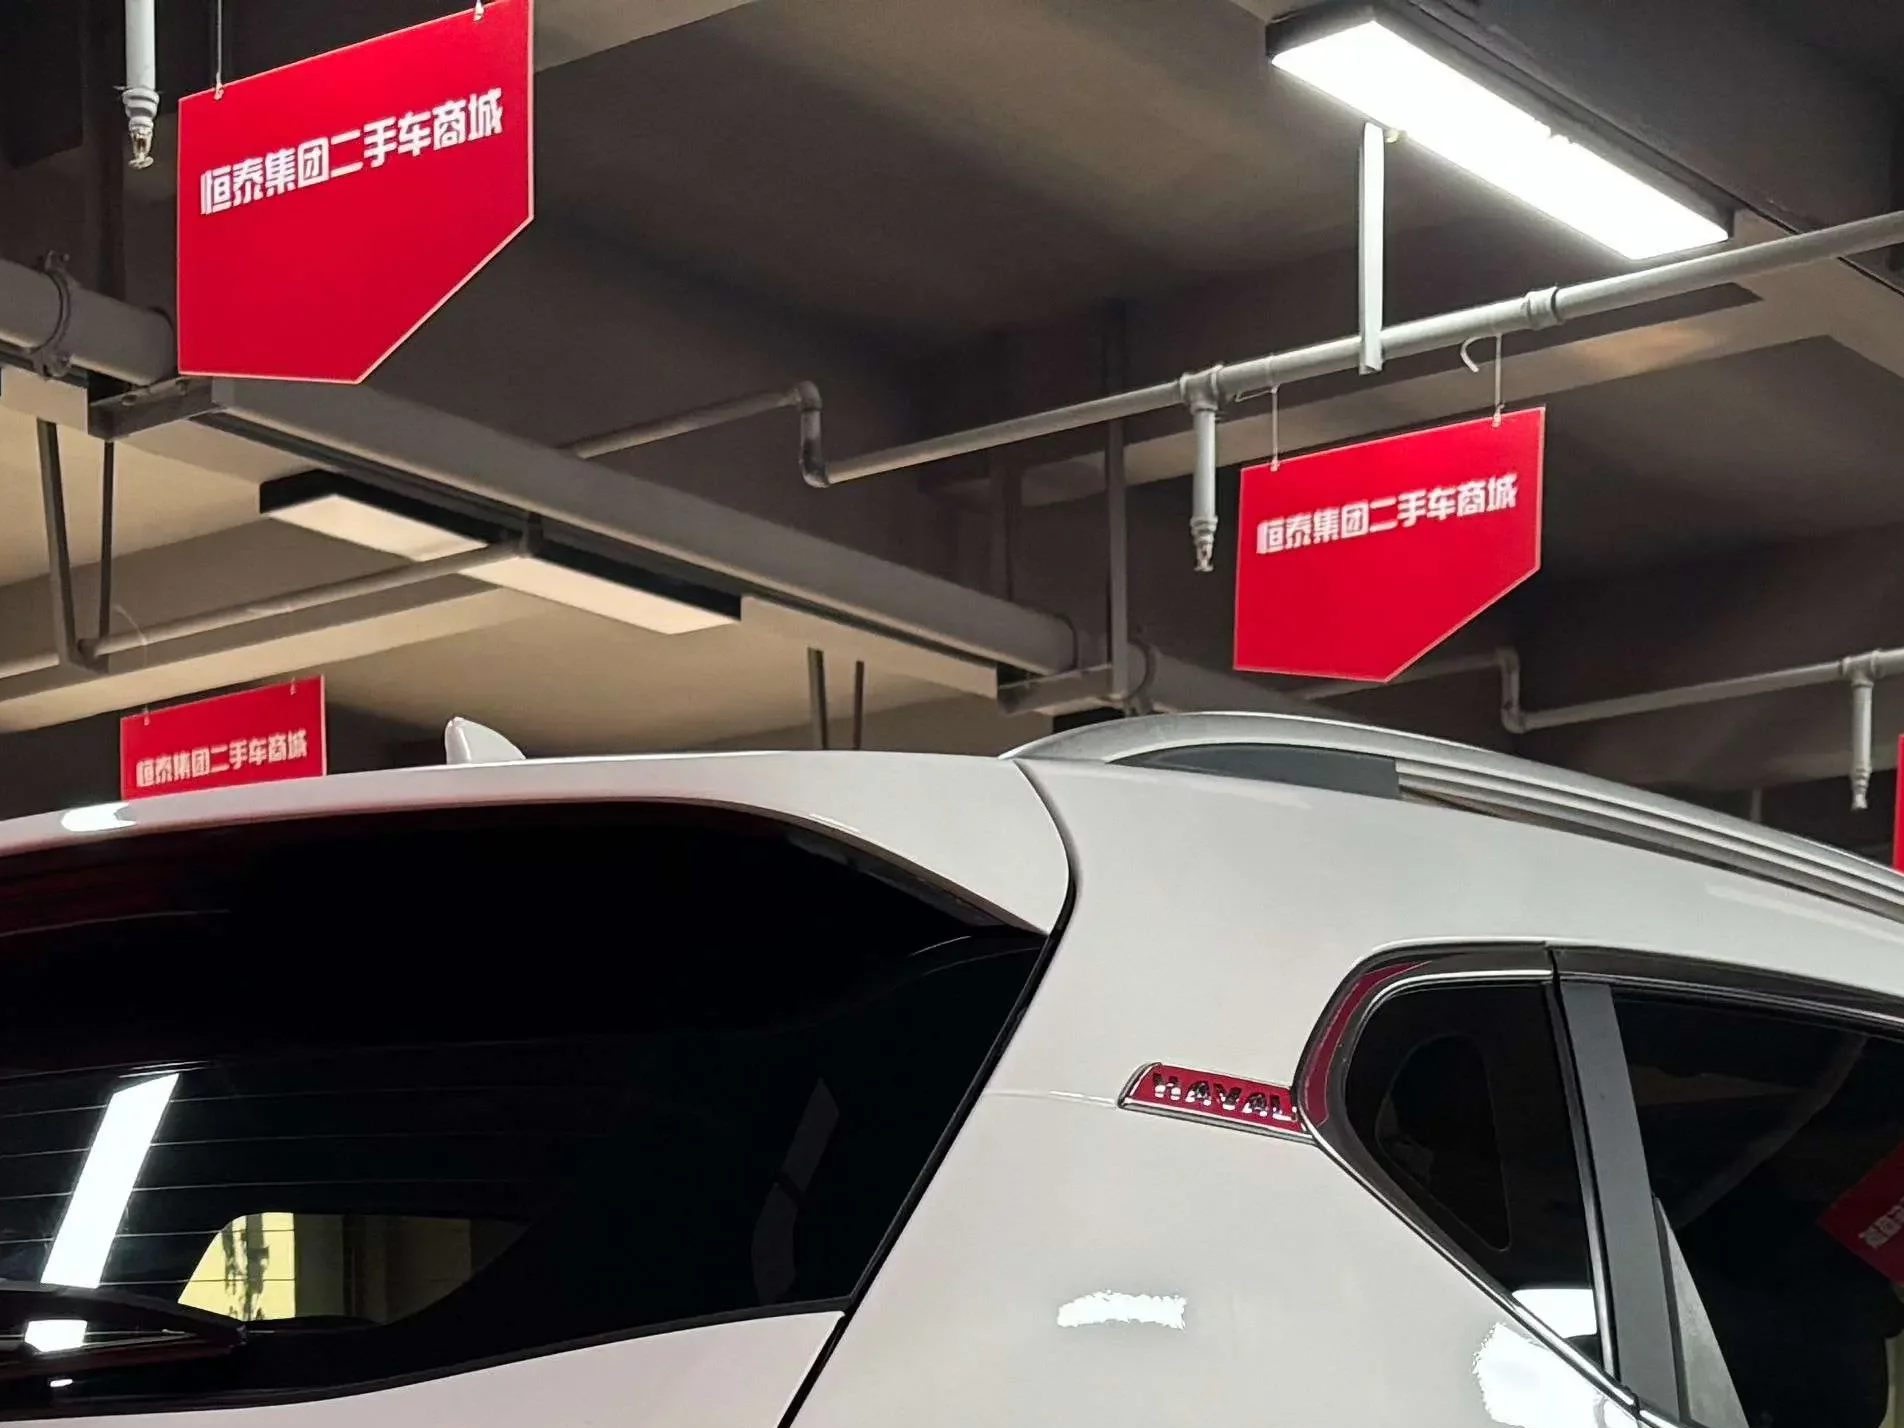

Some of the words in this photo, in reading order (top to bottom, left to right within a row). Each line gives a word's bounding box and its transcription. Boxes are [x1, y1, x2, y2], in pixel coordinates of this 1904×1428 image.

[200, 87, 503, 215] 恒泰集团二手车商城
[1256, 473, 1518, 555] 恒泰集团二手车商城
[136, 728, 308, 787] 恒泰集团二手车商城
[1152, 1073, 1297, 1121] HAVAL
